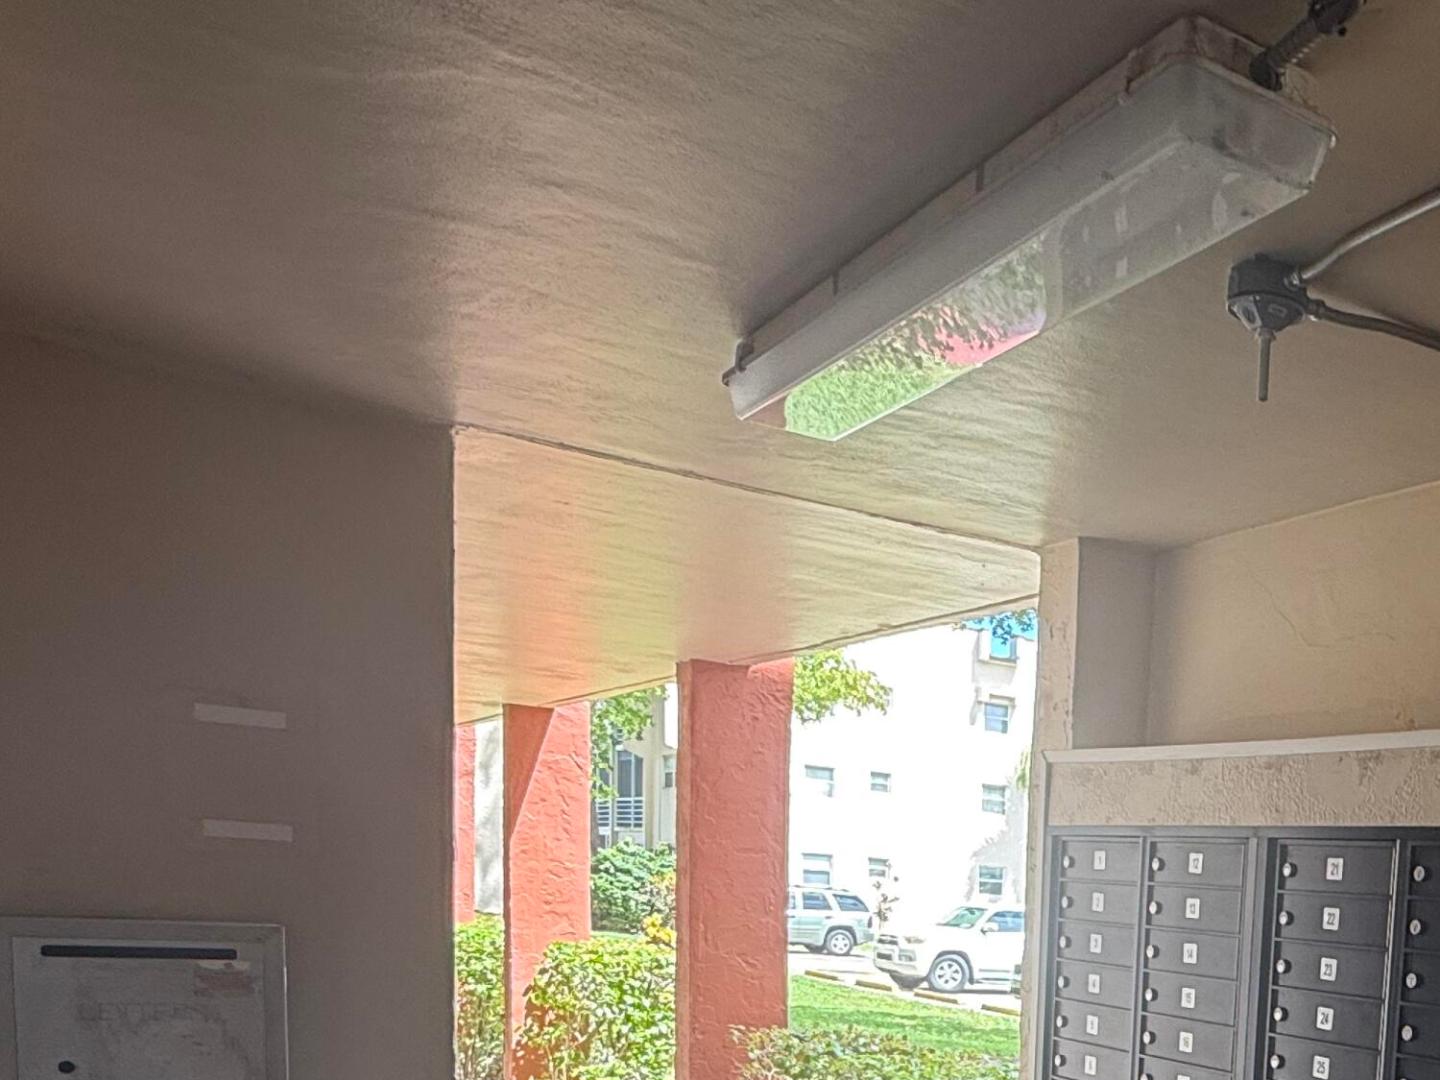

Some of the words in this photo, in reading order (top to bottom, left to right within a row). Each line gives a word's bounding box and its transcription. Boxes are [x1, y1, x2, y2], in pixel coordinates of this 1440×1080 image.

[1330, 863, 1340, 876] 21
[1326, 912, 1336, 926] 22
[1323, 964, 1333, 976] 23
[1320, 1012, 1330, 1024] 24
[1316, 1061, 1326, 1074] 25
